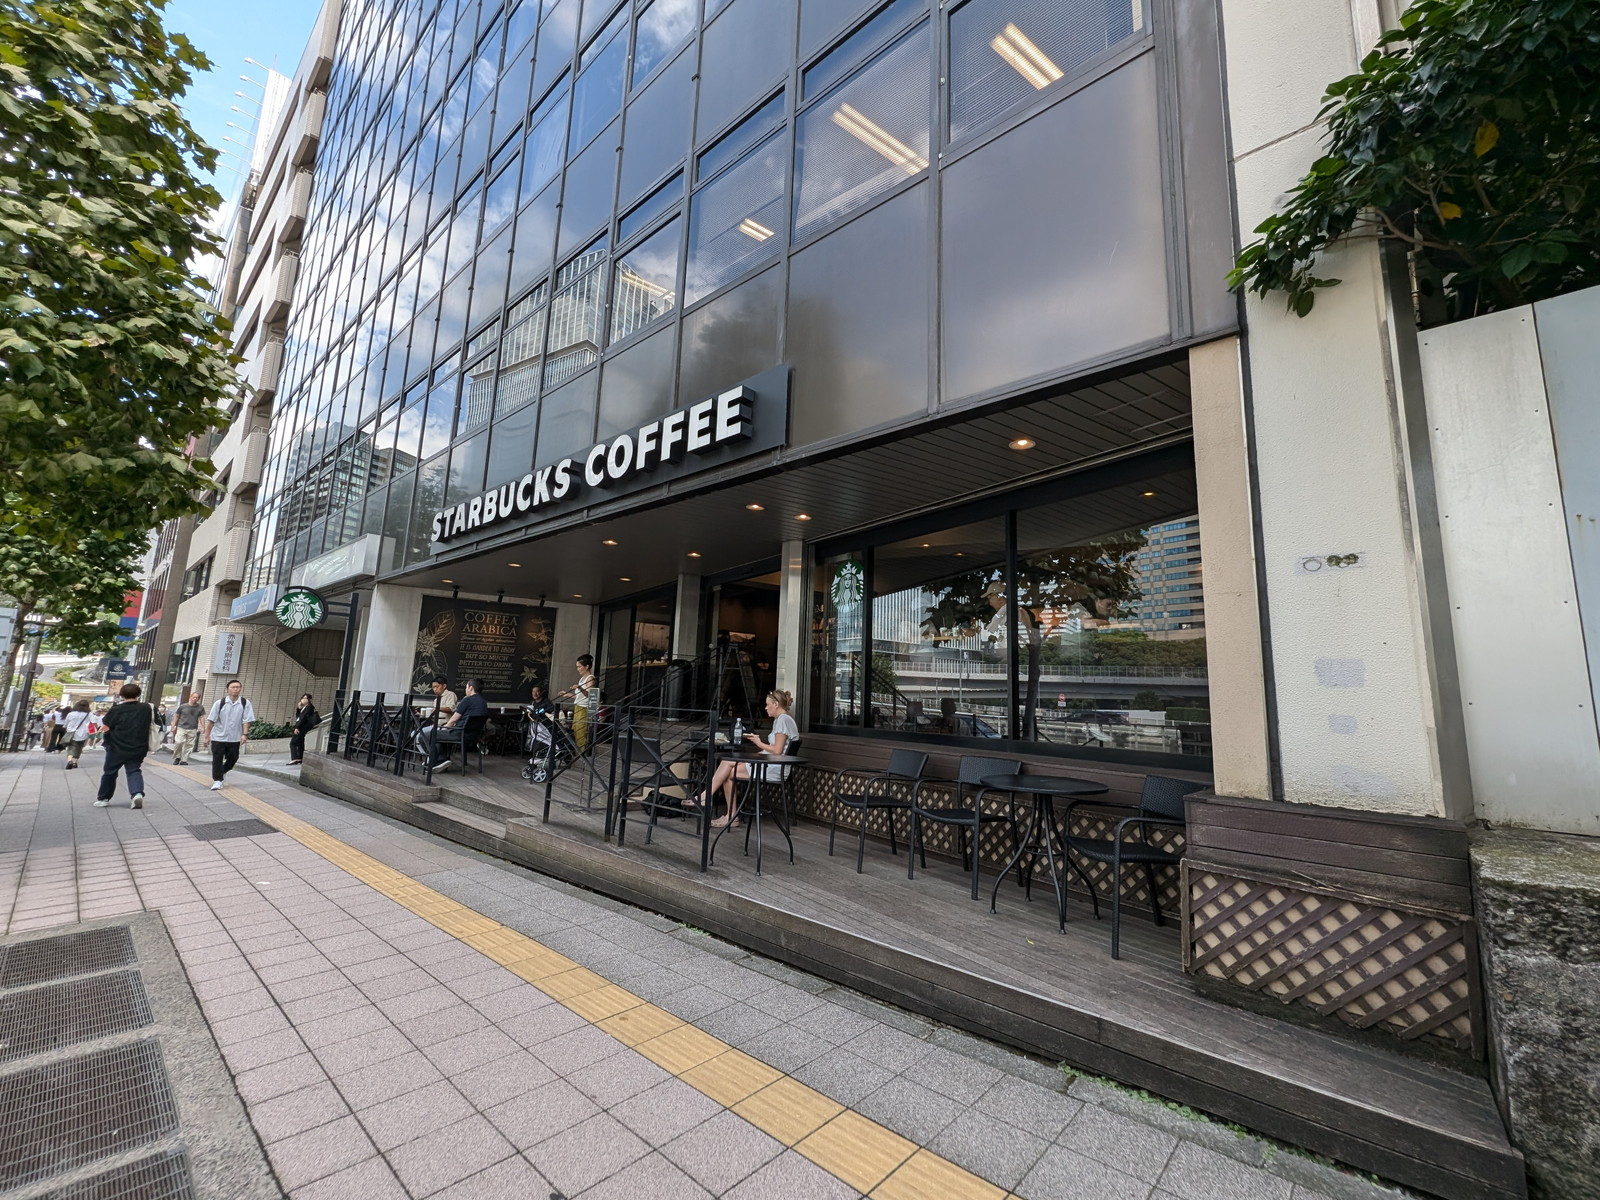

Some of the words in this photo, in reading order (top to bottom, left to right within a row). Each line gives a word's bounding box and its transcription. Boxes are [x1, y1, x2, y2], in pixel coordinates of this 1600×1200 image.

[430, 458, 572, 542] STARBUCKS
[584, 385, 745, 488] COFFEE
[464, 612, 517, 625] COFFEA
[462, 623, 516, 636] ARABICA
